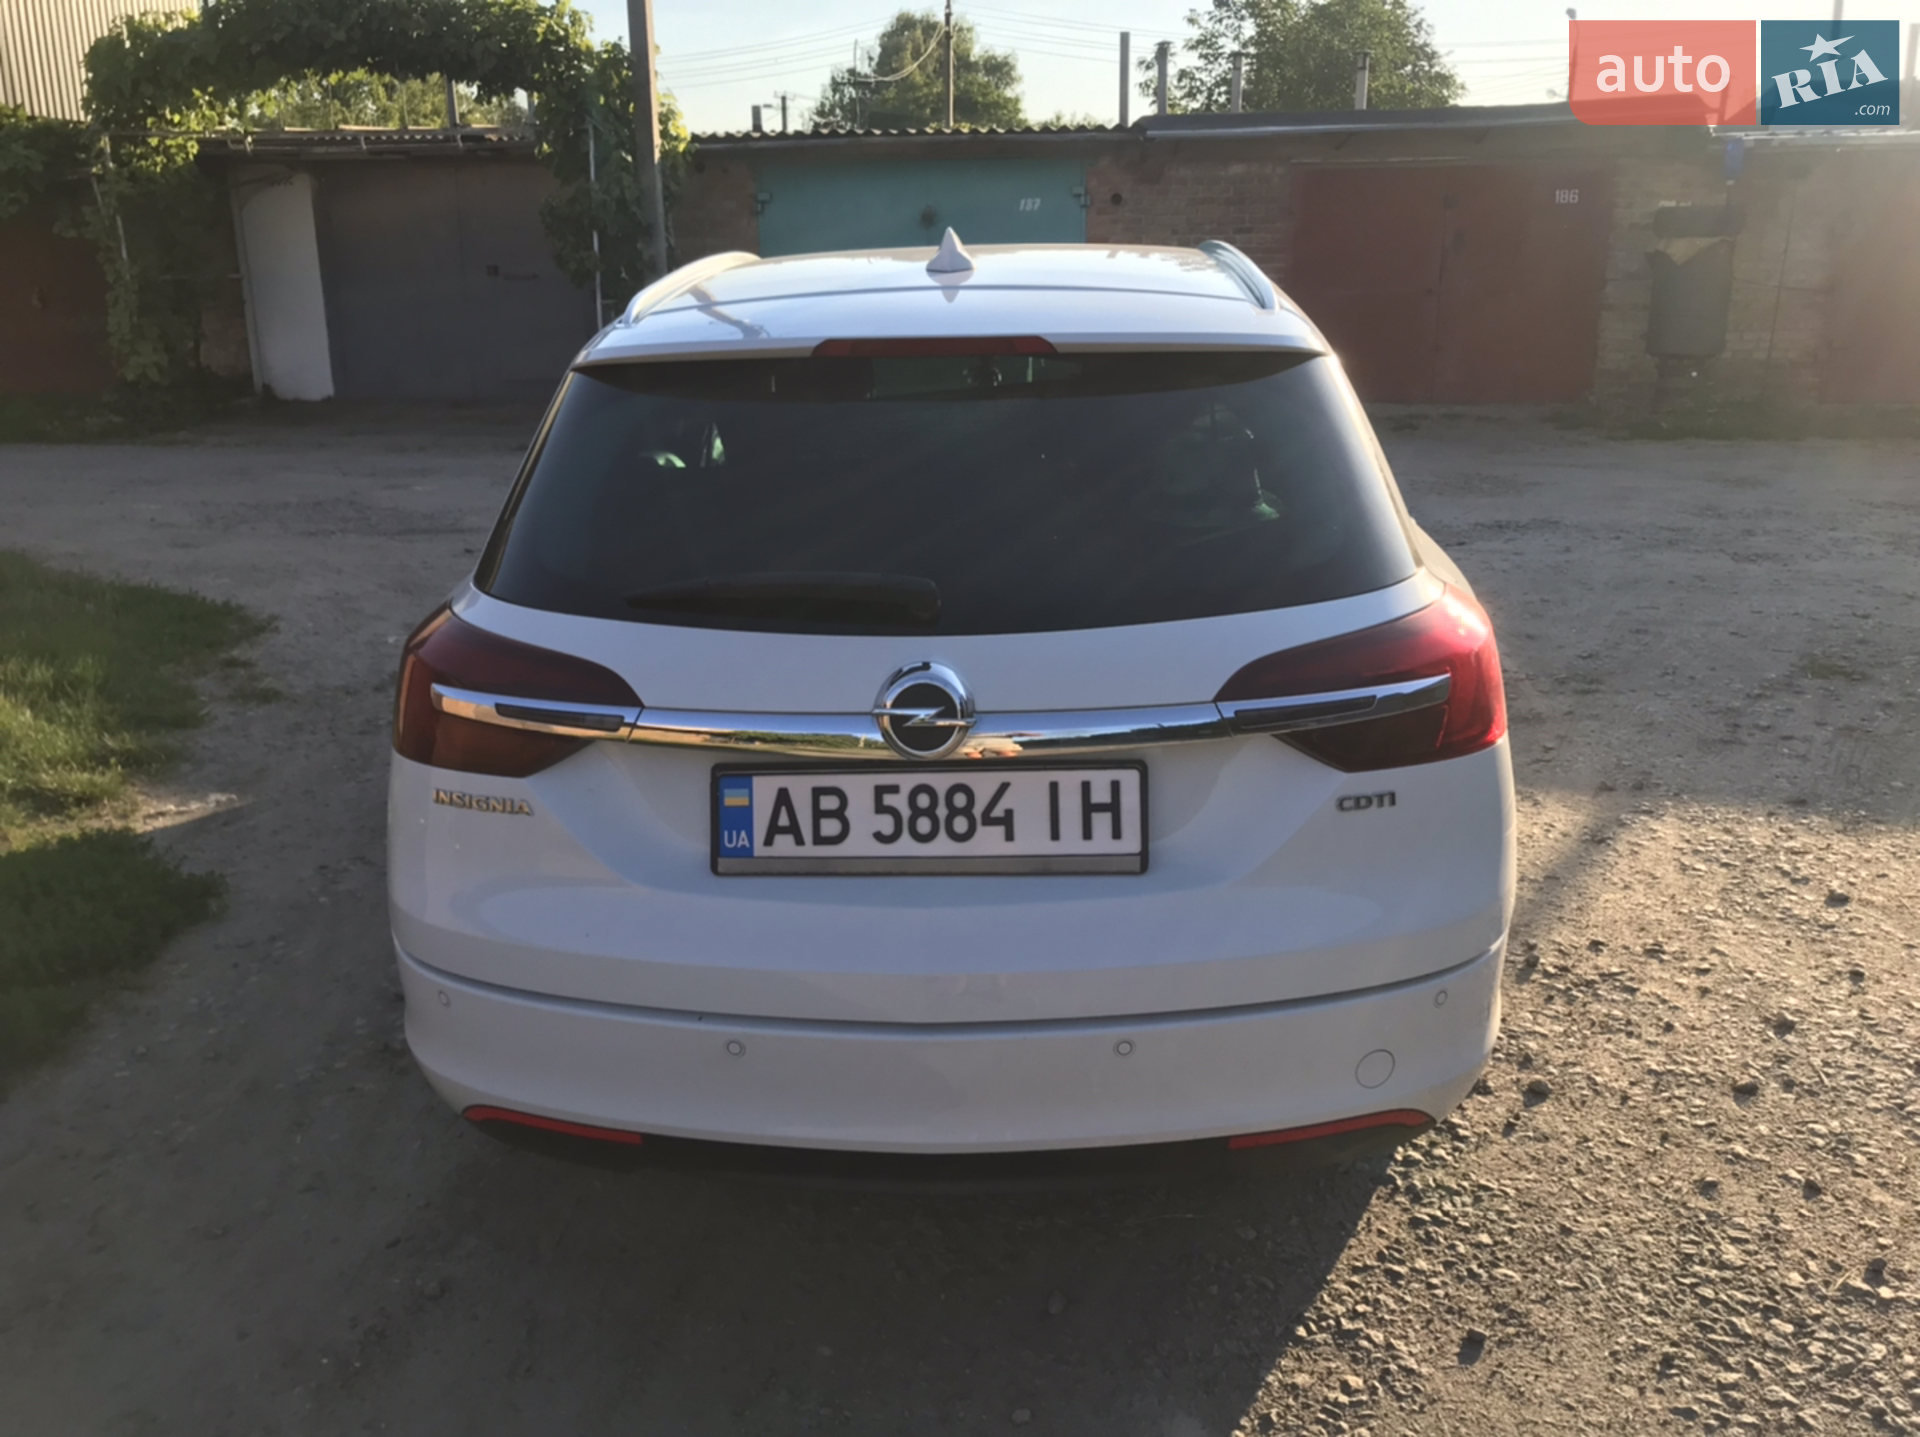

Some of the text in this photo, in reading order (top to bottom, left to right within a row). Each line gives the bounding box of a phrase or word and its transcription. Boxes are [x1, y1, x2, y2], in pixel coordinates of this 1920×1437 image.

[1019, 198, 1041, 211] 187
[1555, 189, 1579, 204] 186
[432, 788, 535, 816] INSIGNIA
[1335, 791, 1397, 812] CDTI
[762, 780, 1122, 847] AB 5884 IH
[723, 830, 750, 848] UA
